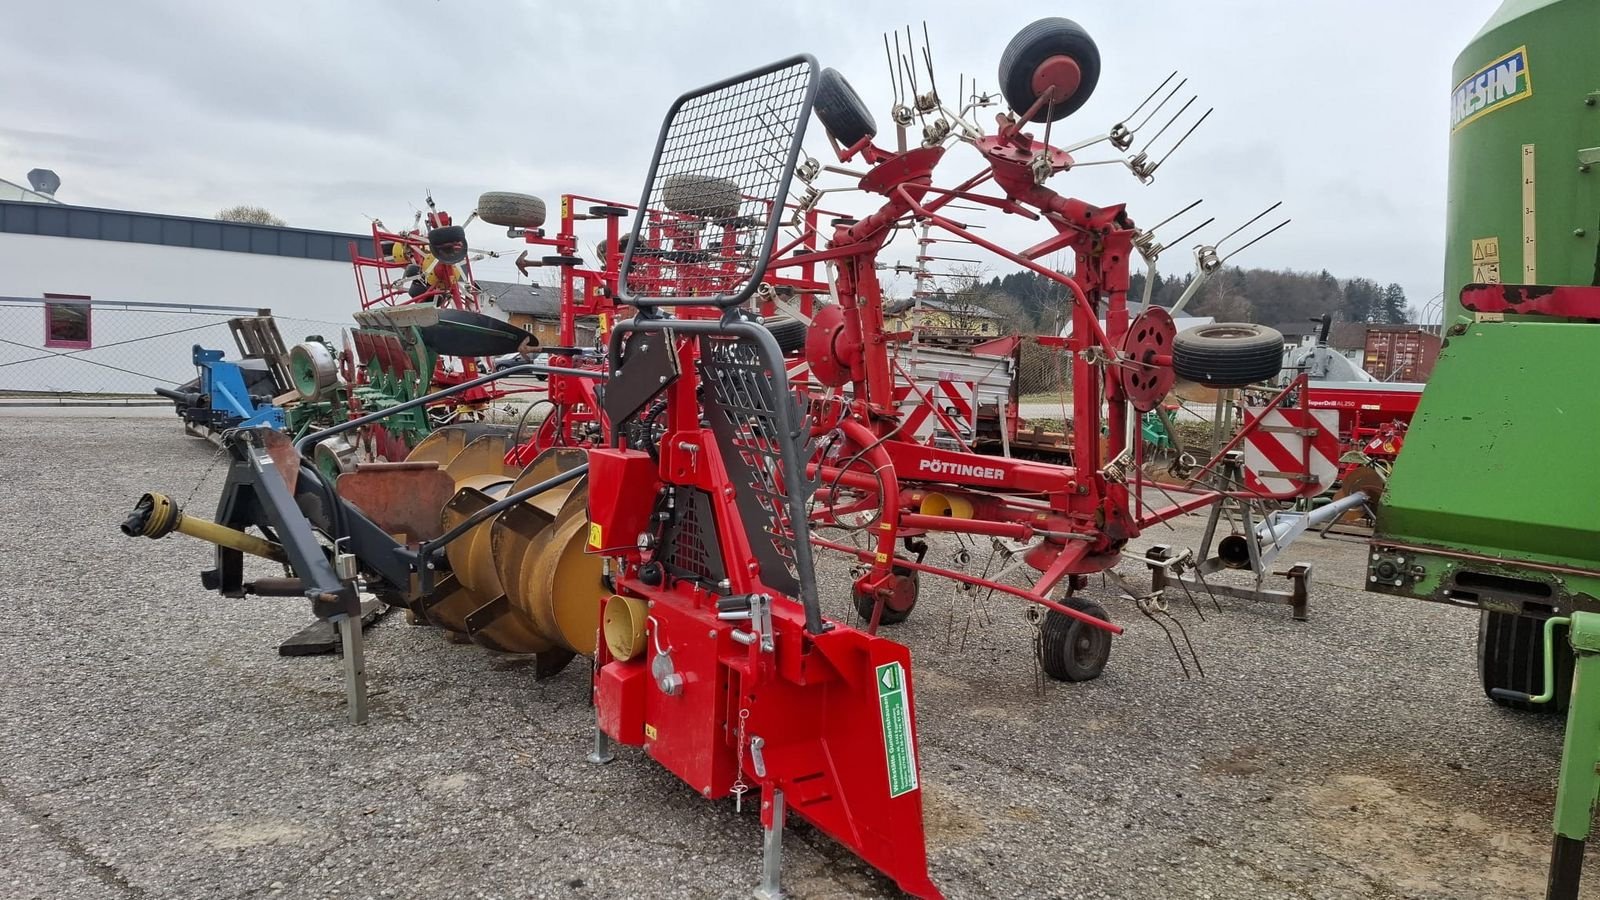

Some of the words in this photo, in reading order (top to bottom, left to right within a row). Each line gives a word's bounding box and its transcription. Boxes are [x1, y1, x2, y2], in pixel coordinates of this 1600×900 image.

[1308, 399, 1336, 407] SuperDrill
[919, 459, 1005, 480] PÖTTINGER
[884, 696, 894, 754] Gundertshausen
